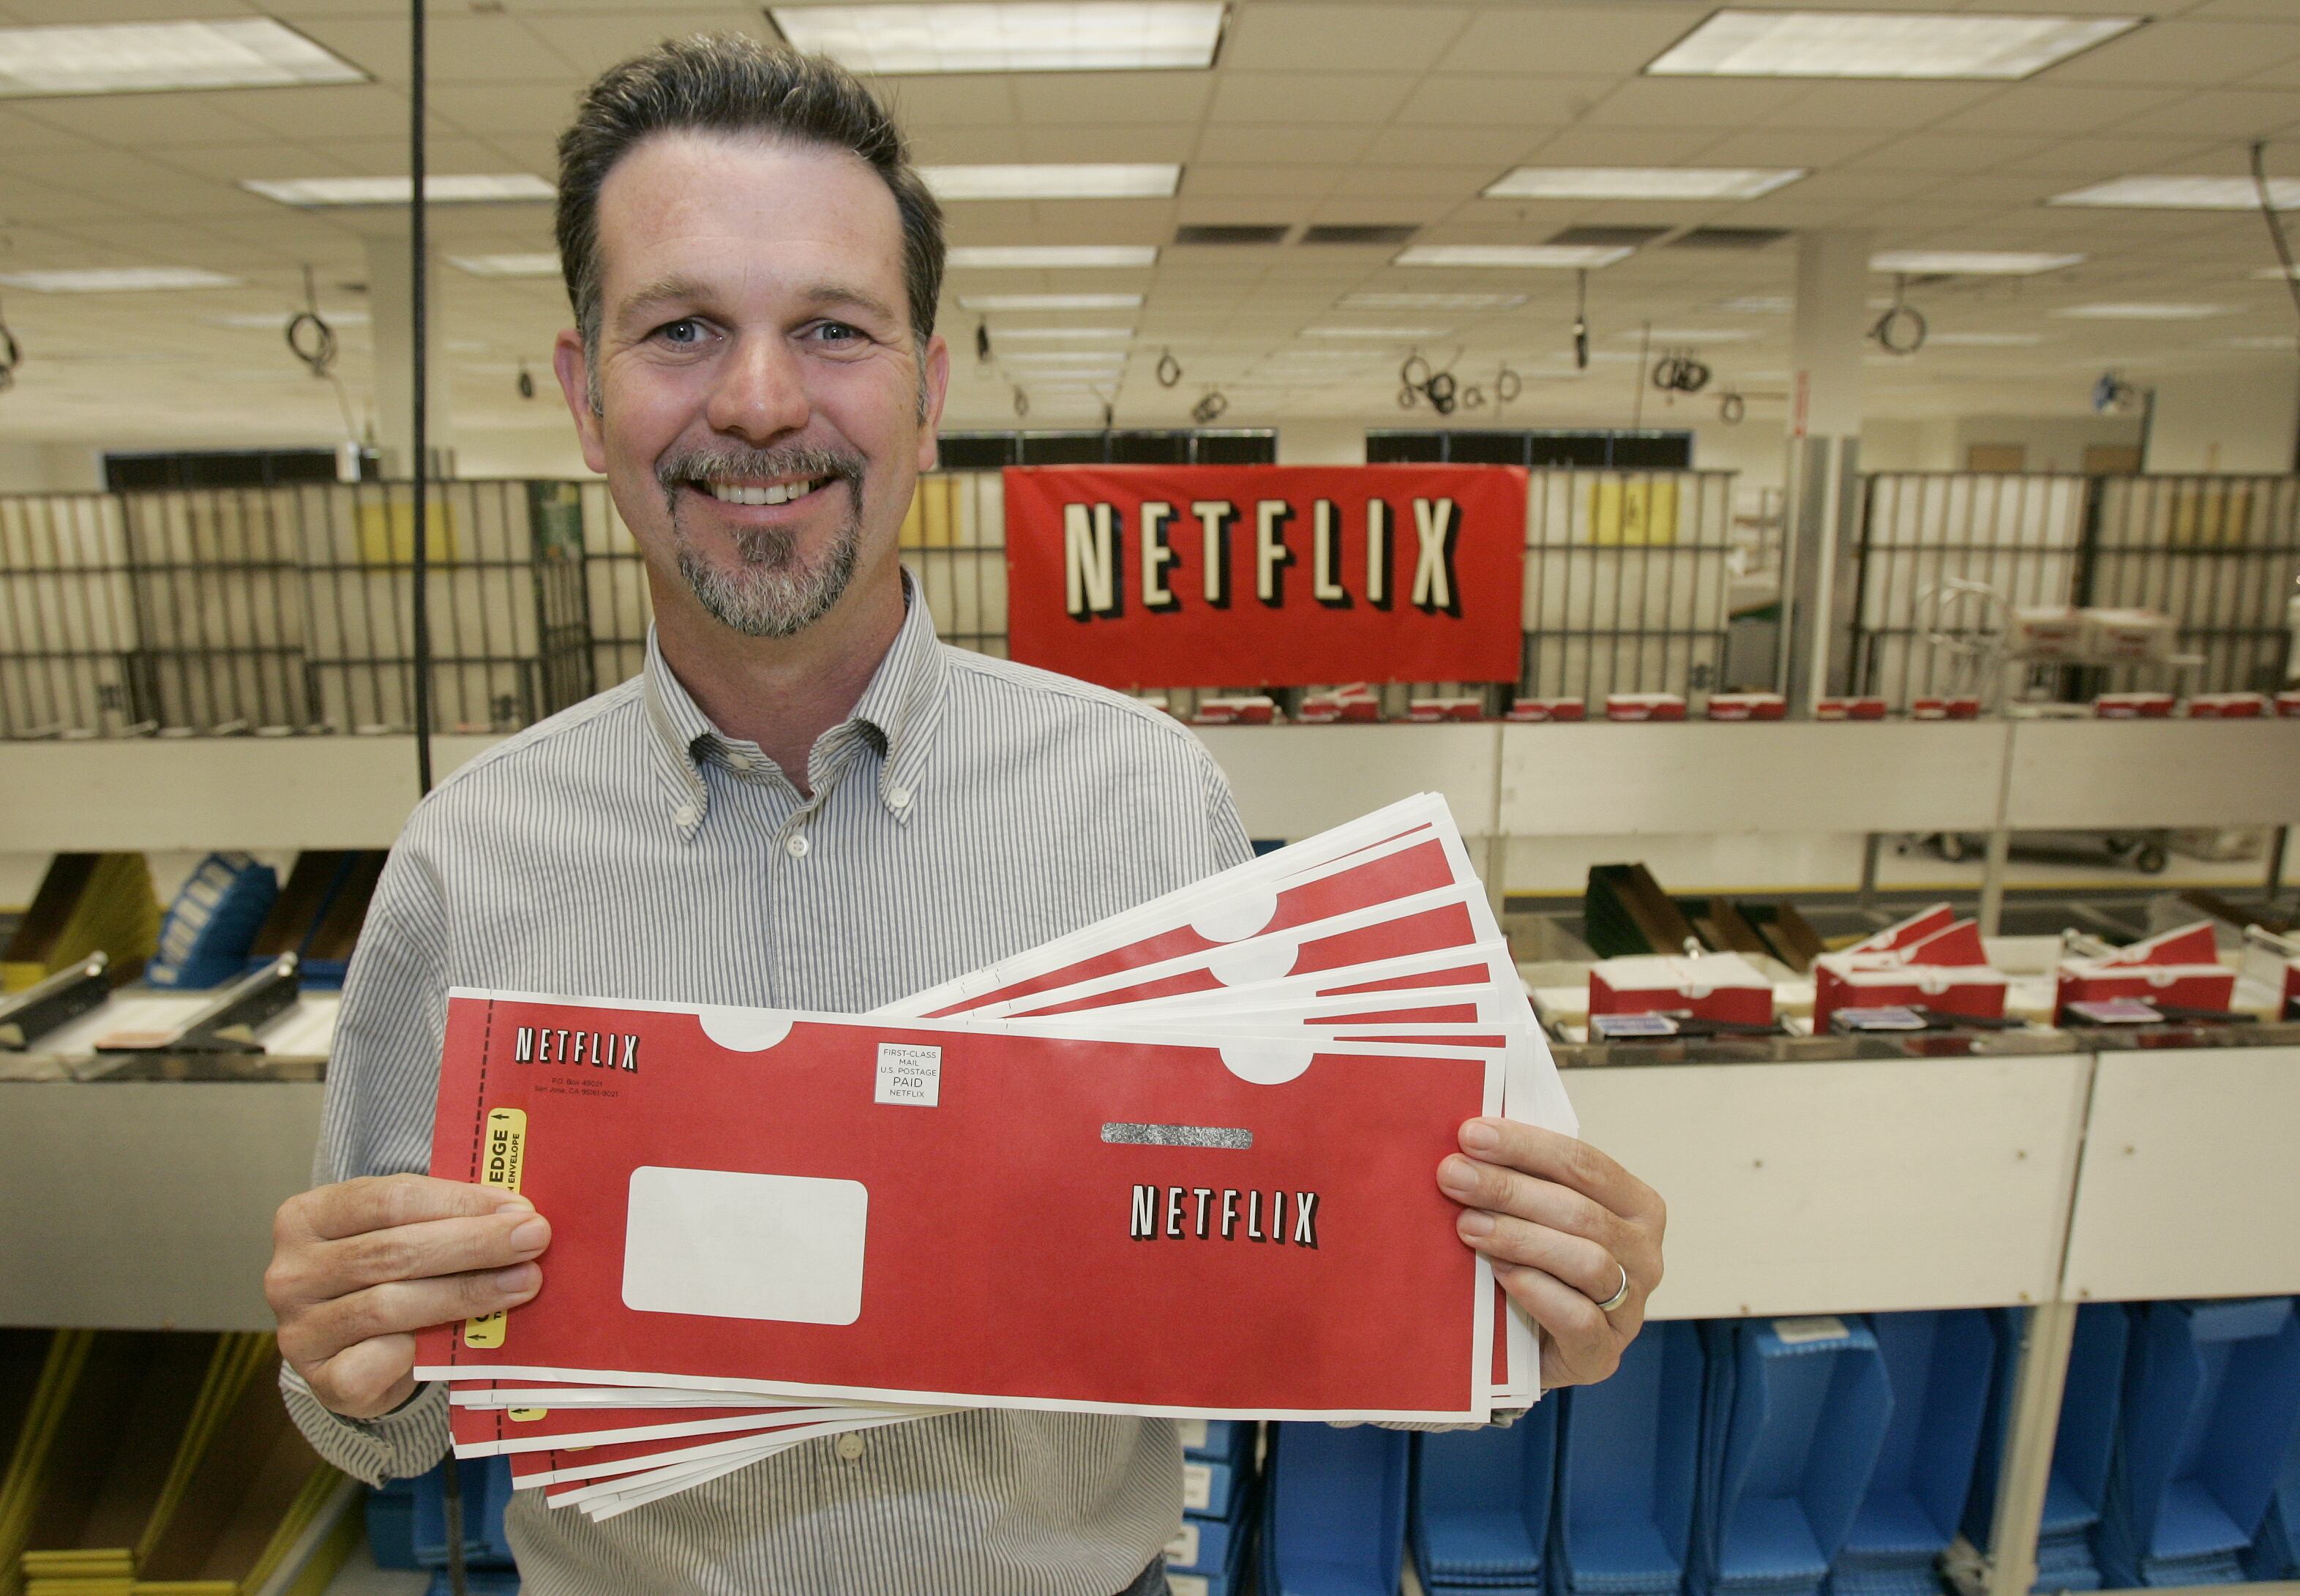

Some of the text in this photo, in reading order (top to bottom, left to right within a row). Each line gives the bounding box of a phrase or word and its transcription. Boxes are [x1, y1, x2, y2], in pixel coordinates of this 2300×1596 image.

[1063, 497, 1463, 623] NETFLIX
[514, 1026, 640, 1074] NETFLIX
[883, 1049, 937, 1059] FIRST-CLASS
[899, 1058, 919, 1067] MAIL
[893, 1076, 923, 1087] PAID
[898, 1067, 937, 1076] POSTAGE
[889, 1089, 924, 1098] NETFLIX
[489, 1129, 508, 1183] EDGE
[508, 1133, 520, 1183] ENVELOPE
[1131, 1184, 1320, 1250] NETFLIX
